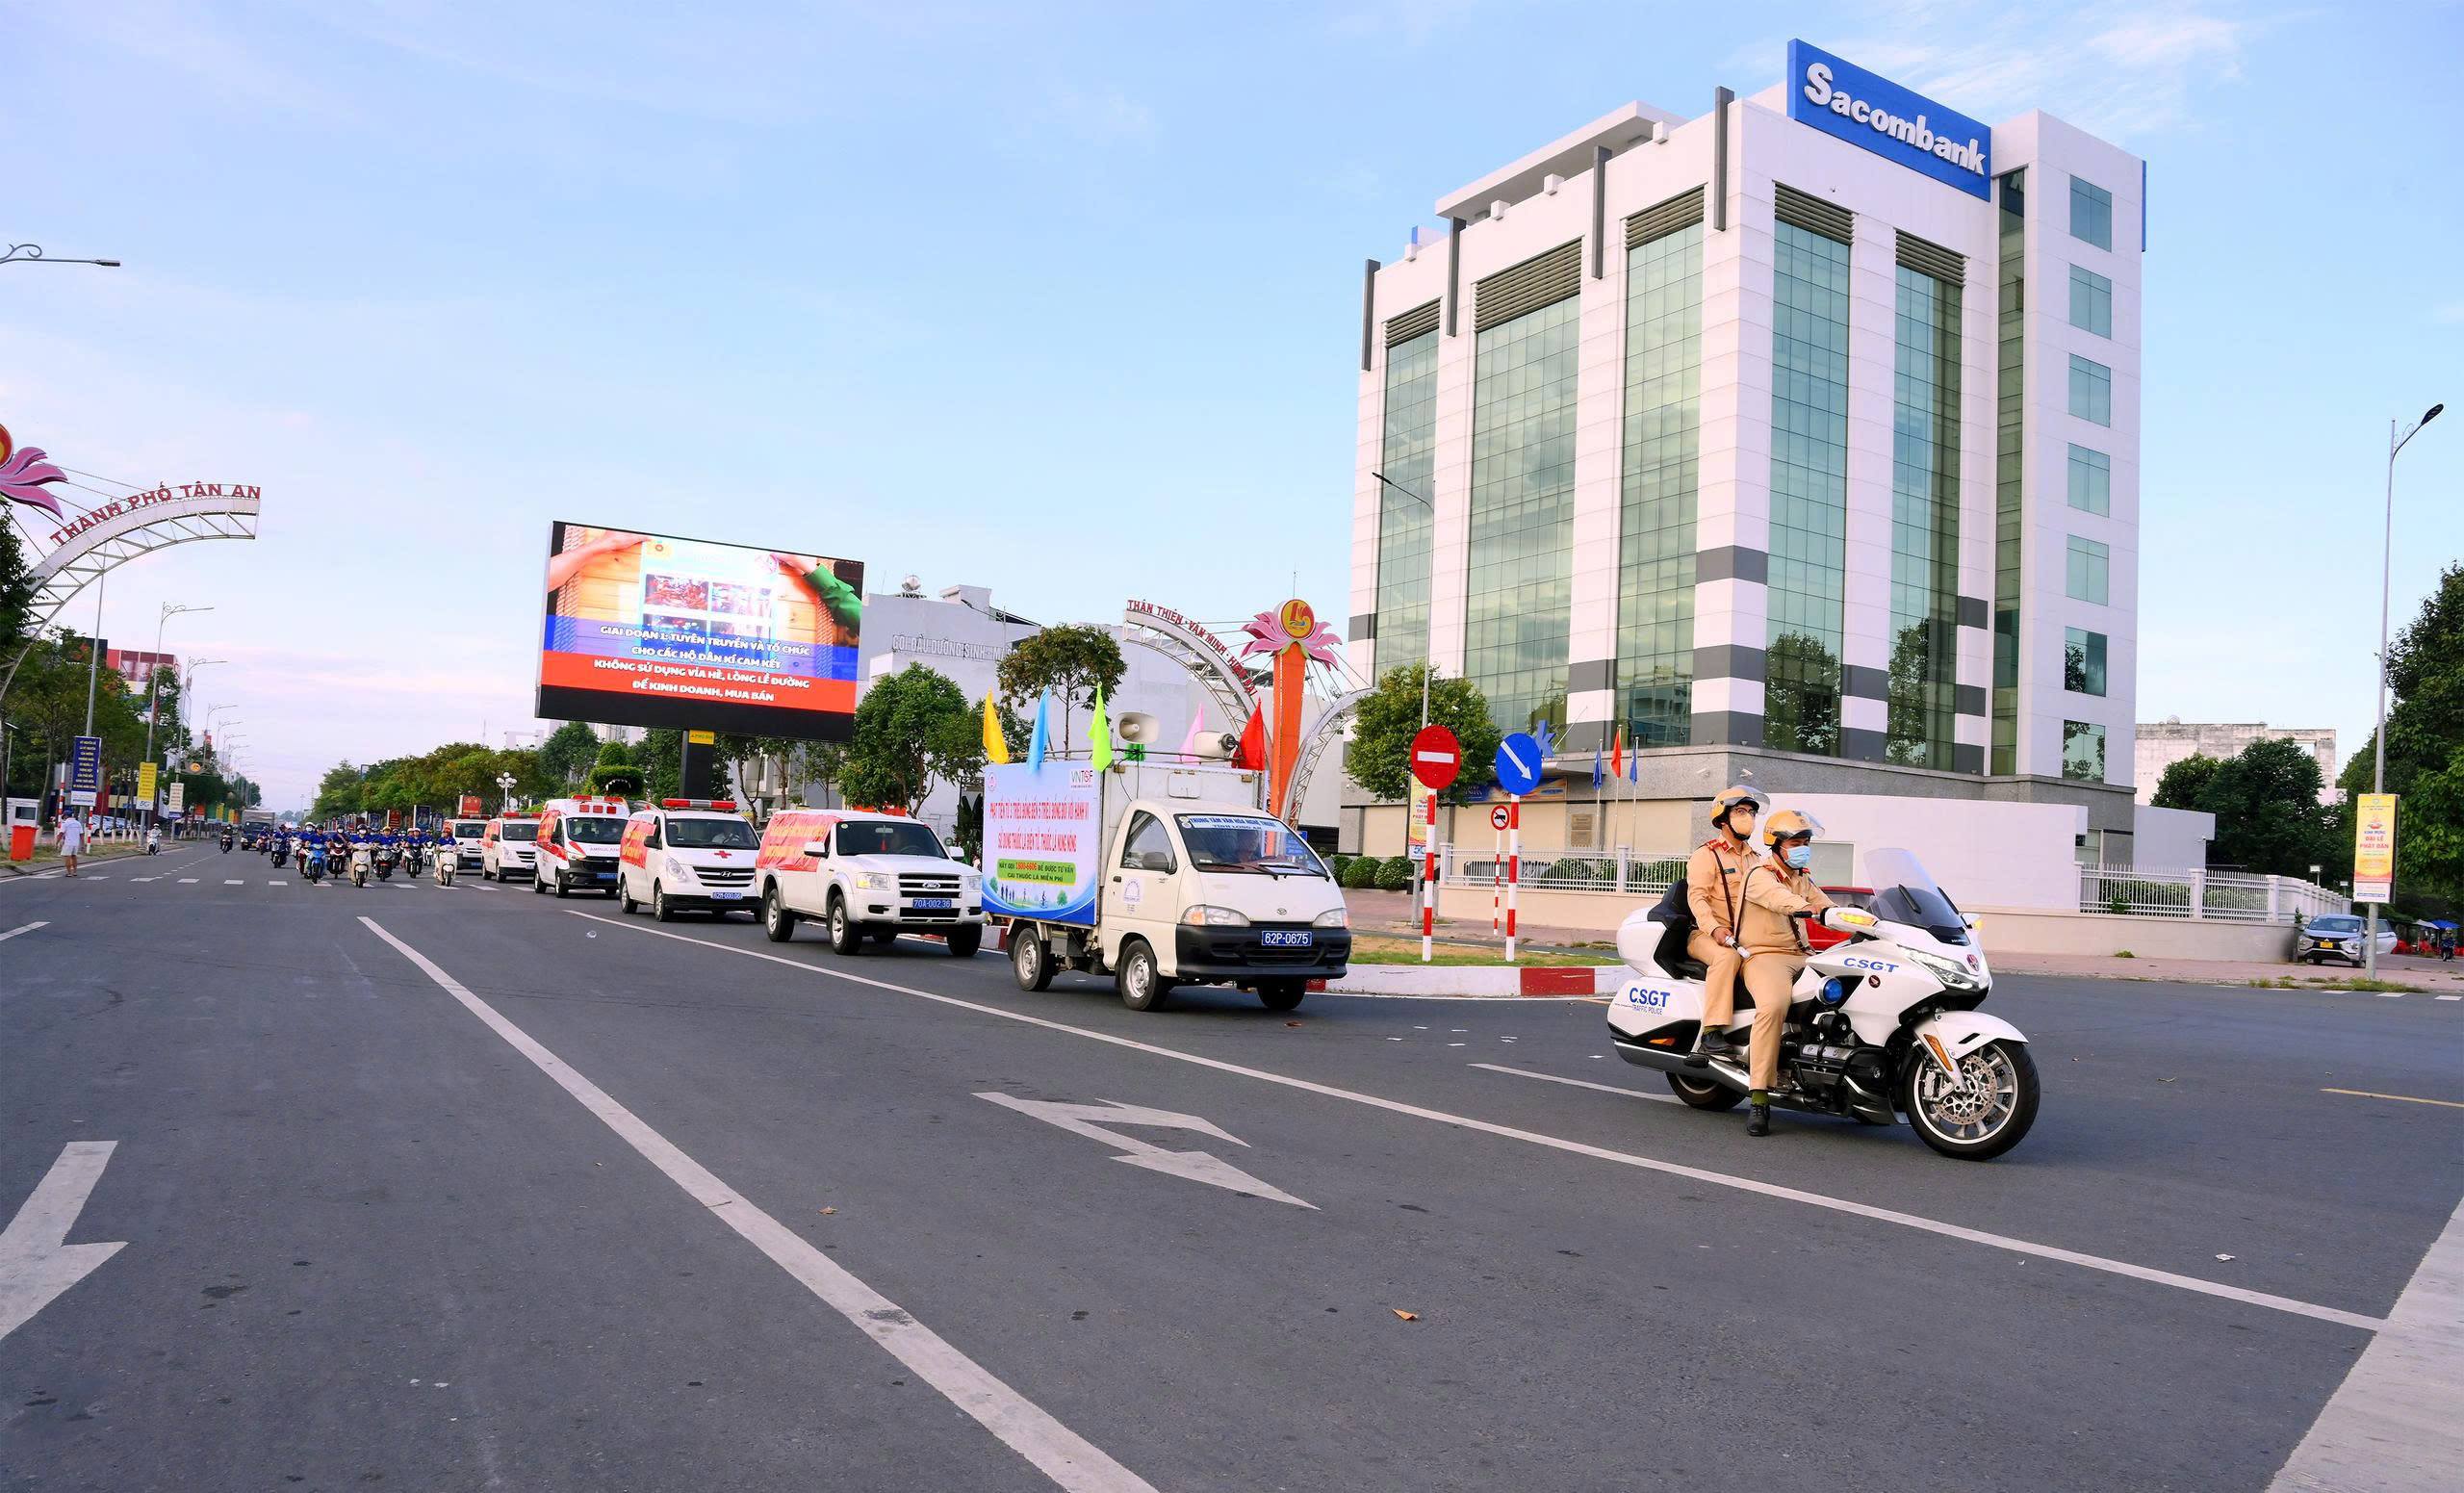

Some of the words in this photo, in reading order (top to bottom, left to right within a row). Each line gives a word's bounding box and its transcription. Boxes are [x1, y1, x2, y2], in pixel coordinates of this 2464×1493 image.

[1804, 63, 1987, 176] Sacombank
[49, 501, 123, 548] THÀNH
[127, 481, 172, 509] PHỐ
[179, 480, 222, 498] TÂN
[231, 485, 261, 500] AN
[601, 626, 624, 635] GIAI
[626, 630, 658, 640] ĐOẠN
[671, 633, 706, 644] TUYÊN
[751, 640, 764, 651] VÀ
[767, 640, 781, 653] TỔ
[782, 645, 810, 656] CHỨC
[964, 643, 986, 659] SINH
[1205, 634, 1227, 655] MINH
[631, 647, 655, 656] CHO
[657, 647, 678, 657] CÁC
[680, 649, 697, 661] HỘ
[737, 657, 760, 667] CAM
[762, 657, 782, 669] KẾT
[594, 659, 636, 671] KHÔNG
[637, 661, 653, 672] SỬ
[654, 665, 686, 677] DỤNG
[727, 671, 756, 683] LÒNG
[770, 676, 810, 688] ĐƯỜNG
[649, 682, 678, 692] KINH
[725, 689, 750, 699] MUA
[751, 690, 774, 701] BÁN
[1265, 933, 1309, 944] 62P-0675
[1629, 987, 1670, 1007] C.S.G.T
